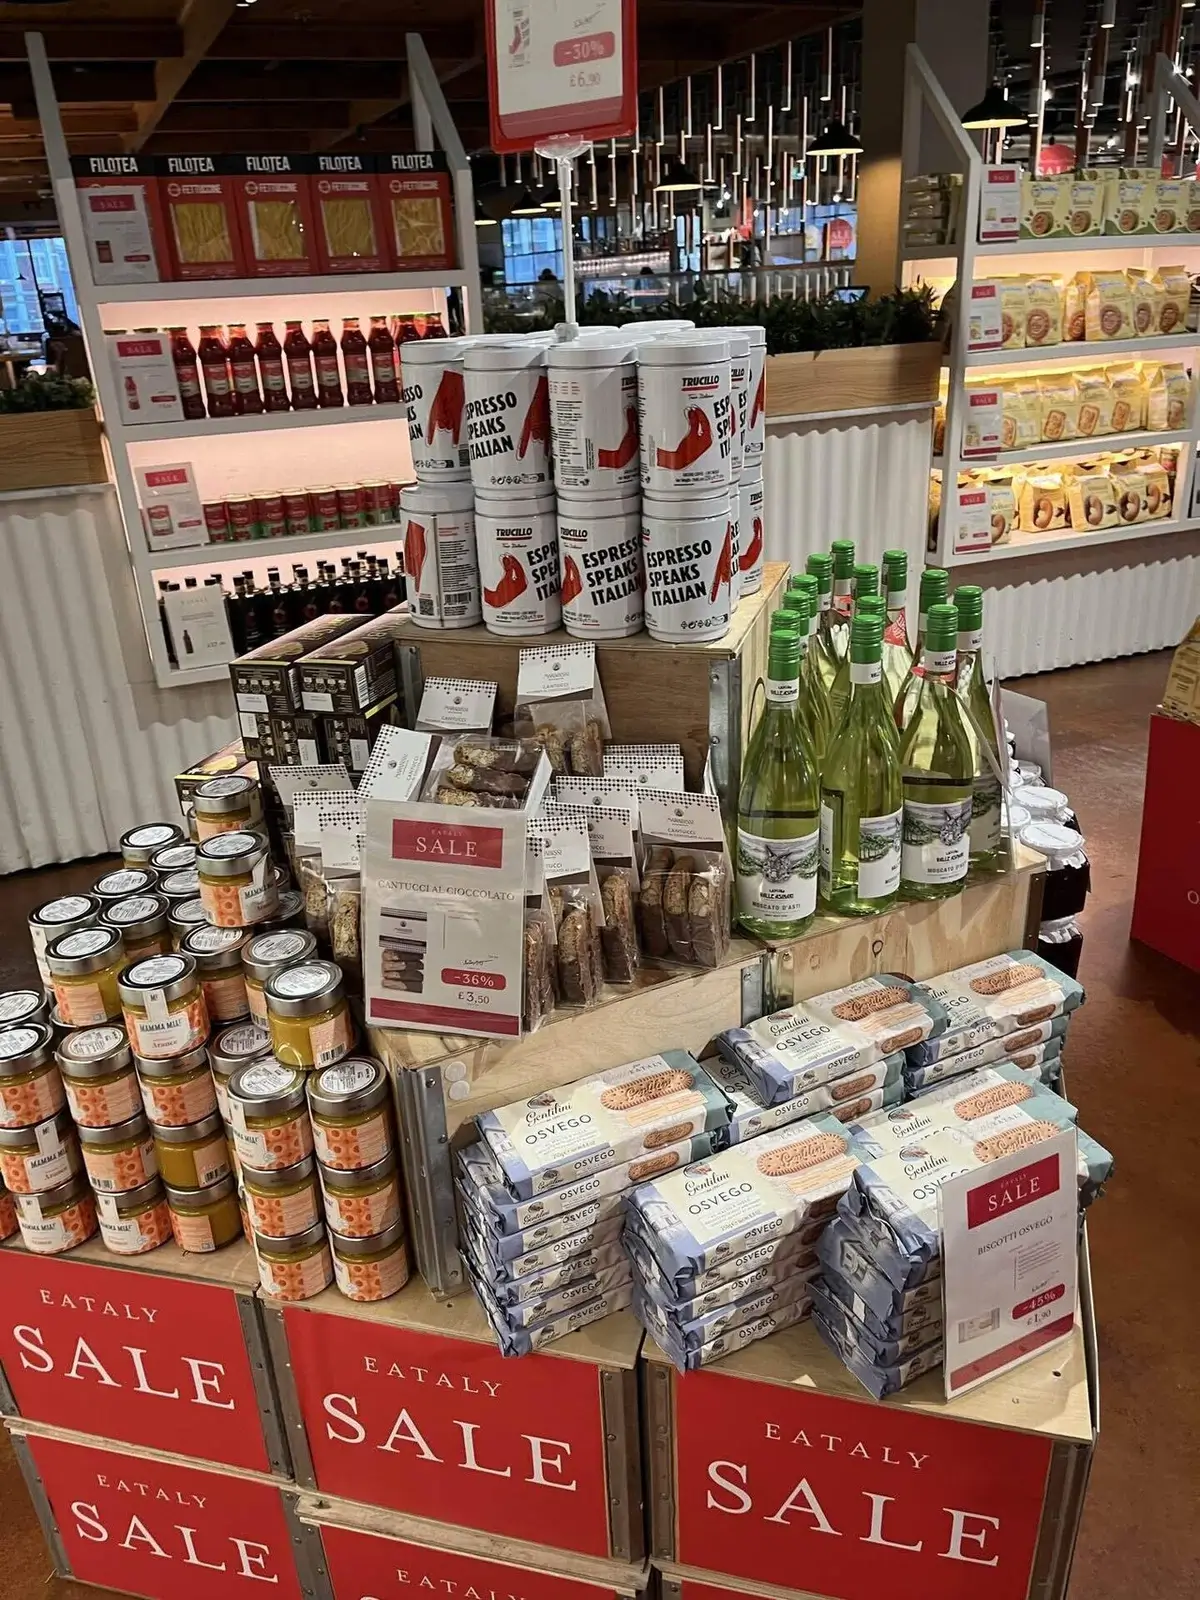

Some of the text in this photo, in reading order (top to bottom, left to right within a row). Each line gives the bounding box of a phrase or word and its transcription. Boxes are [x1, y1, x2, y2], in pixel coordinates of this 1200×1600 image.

[564, 41, 605, 60] -30%
[89, 157, 139, 173] FILOTEA
[168, 157, 215, 173] FILOTEA
[246, 156, 291, 172] FILOTEA
[318, 156, 363, 171] FILOTEA
[391, 155, 434, 169] FILOTEA
[681, 375, 720, 387] TRUCILLO
[465, 391, 517, 421] SPRESSO
[496, 527, 533, 537] TRUCILLO
[560, 527, 588, 538] TRUCILLO
[646, 539, 712, 568] ESPRESSO
[586, 556, 638, 588] SPEAKS
[649, 563, 700, 588] SPEAKS
[652, 581, 707, 607] ITALIAN
[416, 837, 478, 857] SALE
[927, 866, 954, 874] MOSCATO
[378, 879, 515, 901] CANTUCCI AL CIOCCOLATO
[752, 901, 801, 911] MOSCATO D'ASTI
[454, 973, 494, 987] -36%
[458, 991, 490, 1005] £3.50
[139, 1022, 165, 1033] MAMMA
[770, 1016, 809, 1037] Gentilini
[969, 1021, 997, 1039] OVEGO
[776, 1025, 832, 1051] OSVEGO
[827, 1051, 861, 1070] OSVEGO
[954, 1048, 985, 1065] OSVEGO
[526, 1102, 573, 1127] Gentilini
[774, 1097, 810, 1117] OSVEGO
[525, 1114, 592, 1145] OSVEGO
[892, 1116, 932, 1139] Gentilini
[30, 1154, 58, 1169] MAMMA
[574, 1149, 615, 1170] OSVEGO
[904, 1155, 949, 1181] Gentilini
[559, 1179, 600, 1200] OSVEGO
[684, 1171, 730, 1197] Gentilini
[913, 1168, 970, 1200] OSV
[987, 1176, 1042, 1212] SALE
[689, 1182, 753, 1215] OSVEGO
[562, 1202, 601, 1224] OSVEGO
[744, 1218, 783, 1239] OSVEGO
[977, 1215, 1053, 1256] BISCOTTI OSVEGO
[553, 1233, 595, 1252] OSVEGO
[559, 1256, 598, 1277] OVEGO
[735, 1245, 774, 1267] OSVEGO
[731, 1267, 768, 1290] OSVEGO
[562, 1280, 602, 1299] OSVEGO
[1022, 1291, 1056, 1309] -45%
[39, 1289, 159, 1323] EATALY
[569, 1300, 608, 1321] OSVEGO
[741, 1293, 780, 1314] OSVEGO
[738, 1318, 777, 1339] OSVEGO
[13, 1324, 235, 1410] SALE
[363, 1356, 503, 1398] EATALY
[322, 1392, 577, 1491] SALE
[765, 1422, 931, 1469] EATALY
[97, 1474, 207, 1509] EATALY
[706, 1460, 1000, 1567] SALE
[71, 1501, 279, 1584] SALE
[396, 1568, 528, 1600] EATAL
